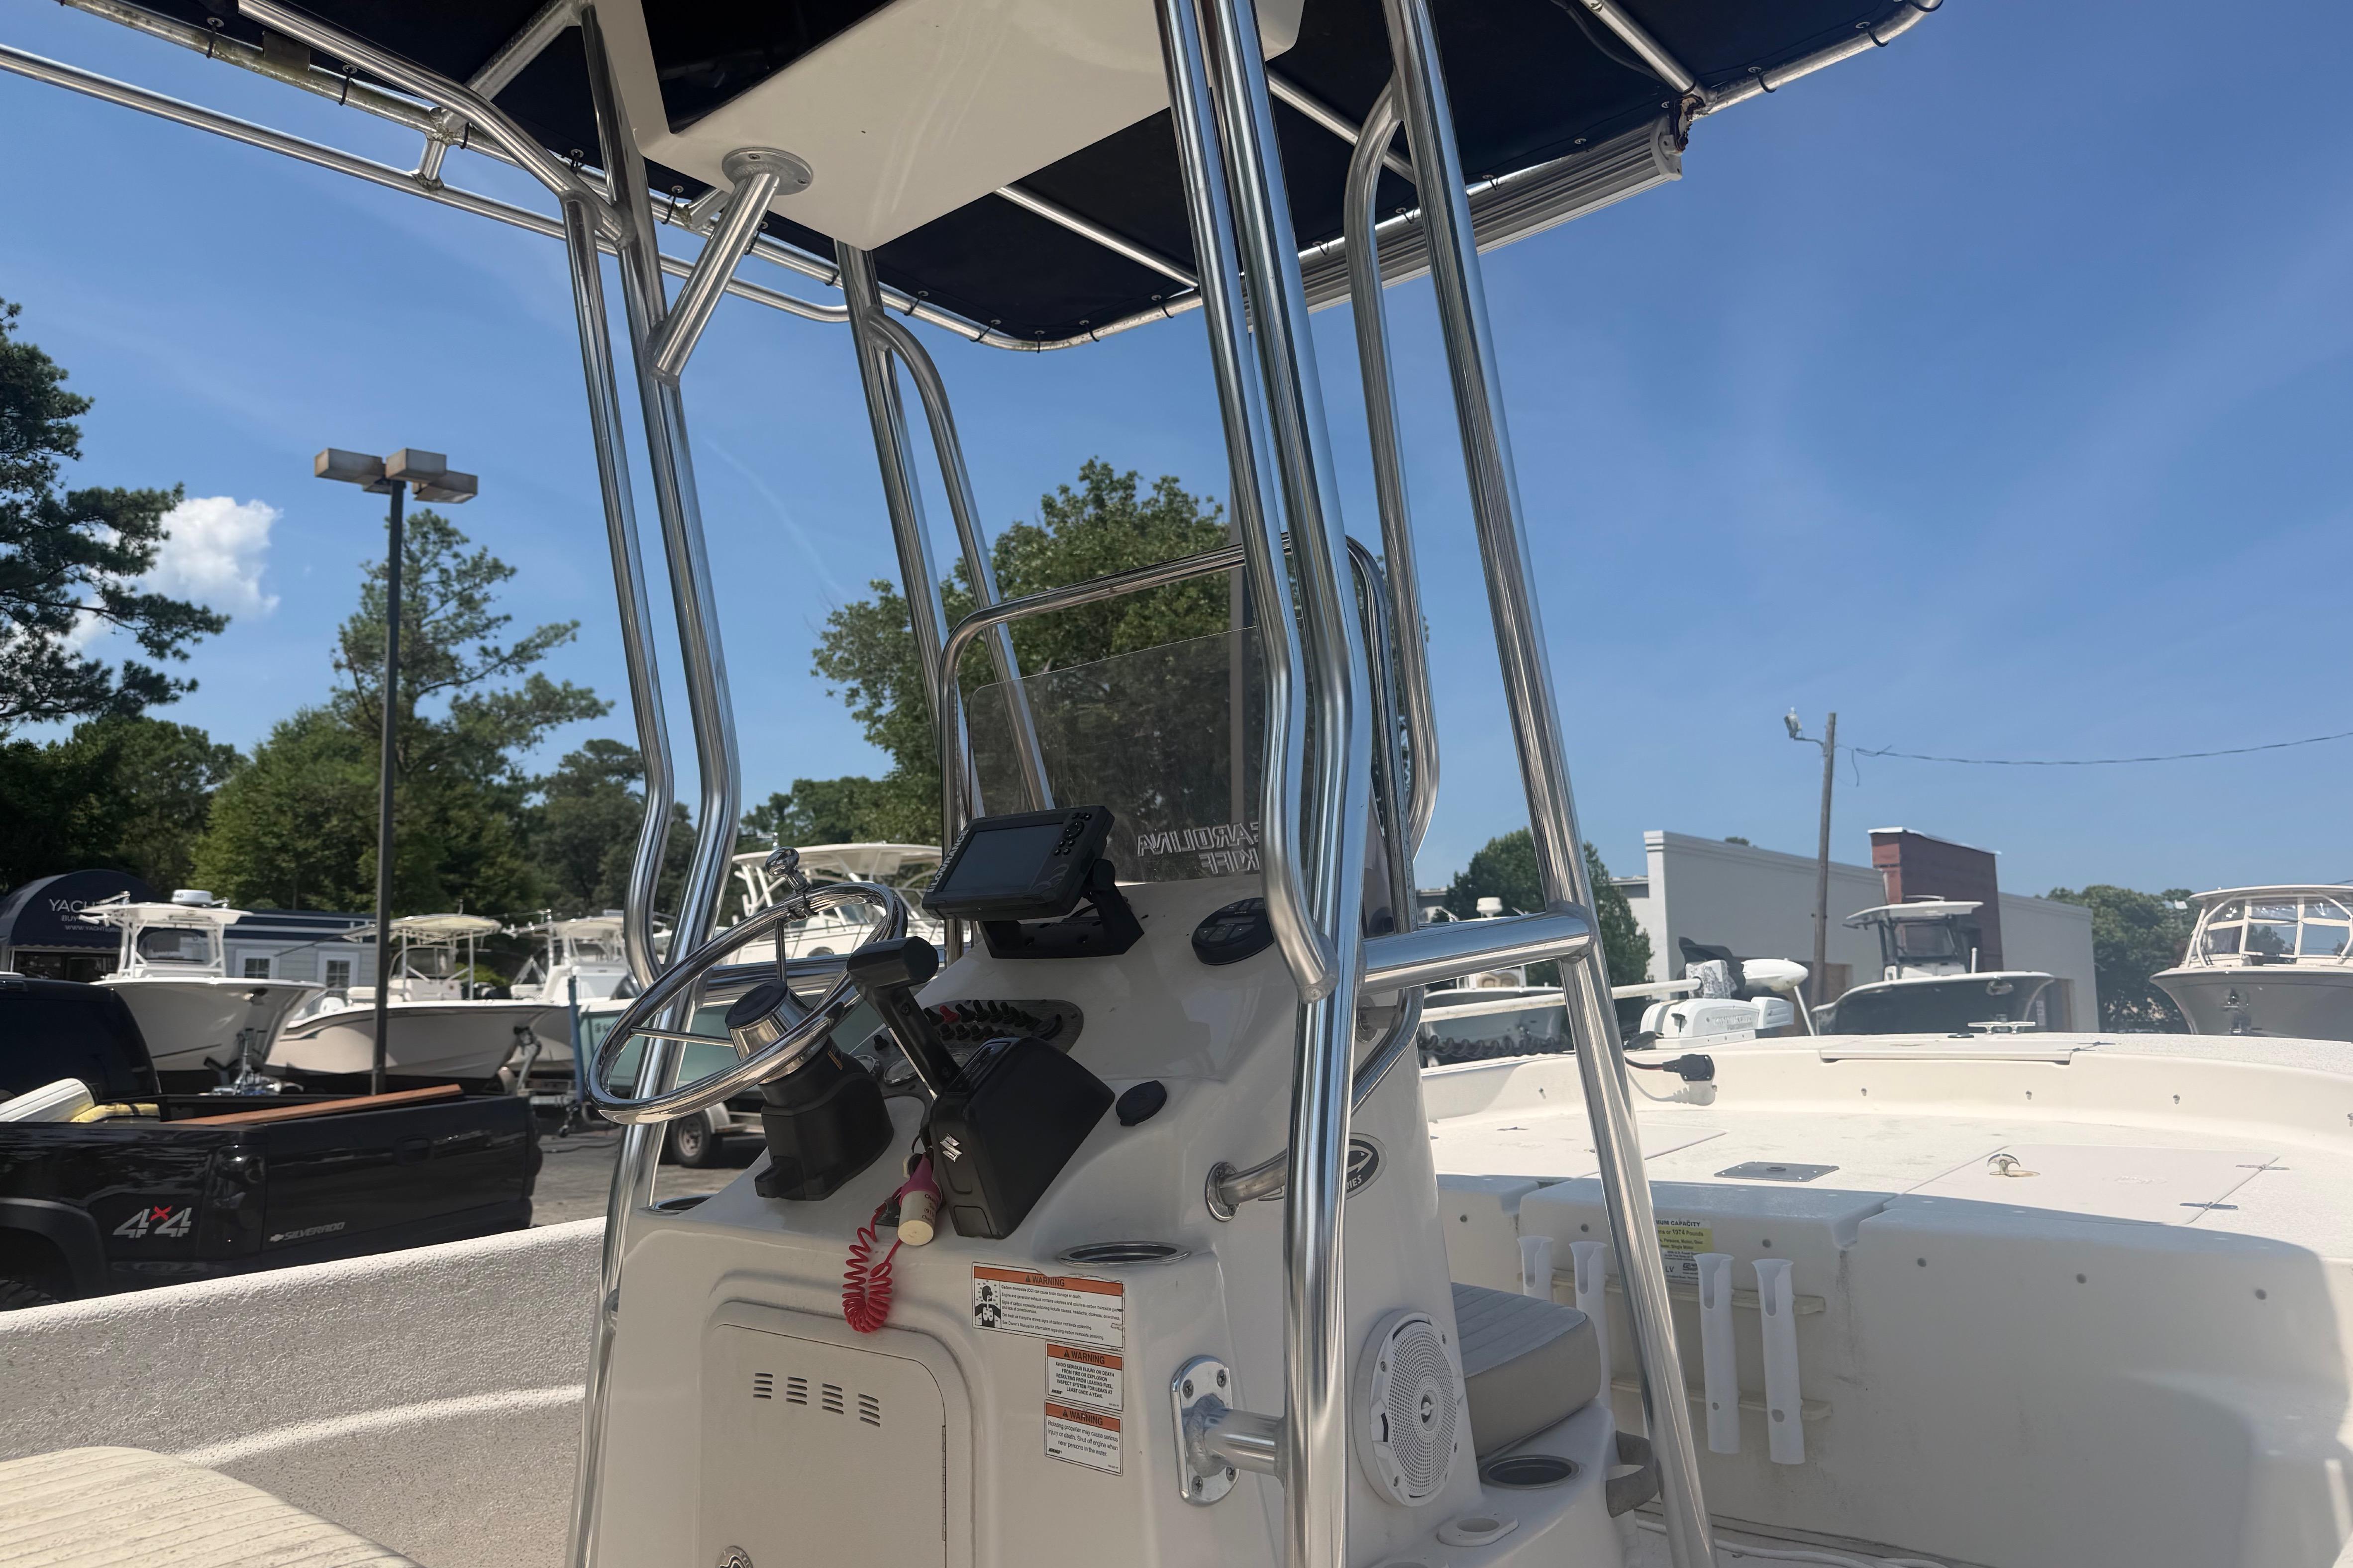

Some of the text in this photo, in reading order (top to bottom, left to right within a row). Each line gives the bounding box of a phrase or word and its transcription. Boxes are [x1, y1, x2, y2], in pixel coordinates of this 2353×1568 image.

[930, 829, 969, 886] LOWRANCE
[1346, 1175, 1362, 1190] RIES
[283, 1221, 345, 1240] SILVERADO
[1032, 1275, 1065, 1287] WARNING
[1071, 1350, 1105, 1365] WARNING
[1087, 1373, 1108, 1382] EXPLOSION
[1087, 1378, 1103, 1387] LEAKING
[1070, 1410, 1103, 1426] WARNING
[1048, 1420, 1064, 1430] Rotating
[1048, 1428, 1059, 1437] injury
